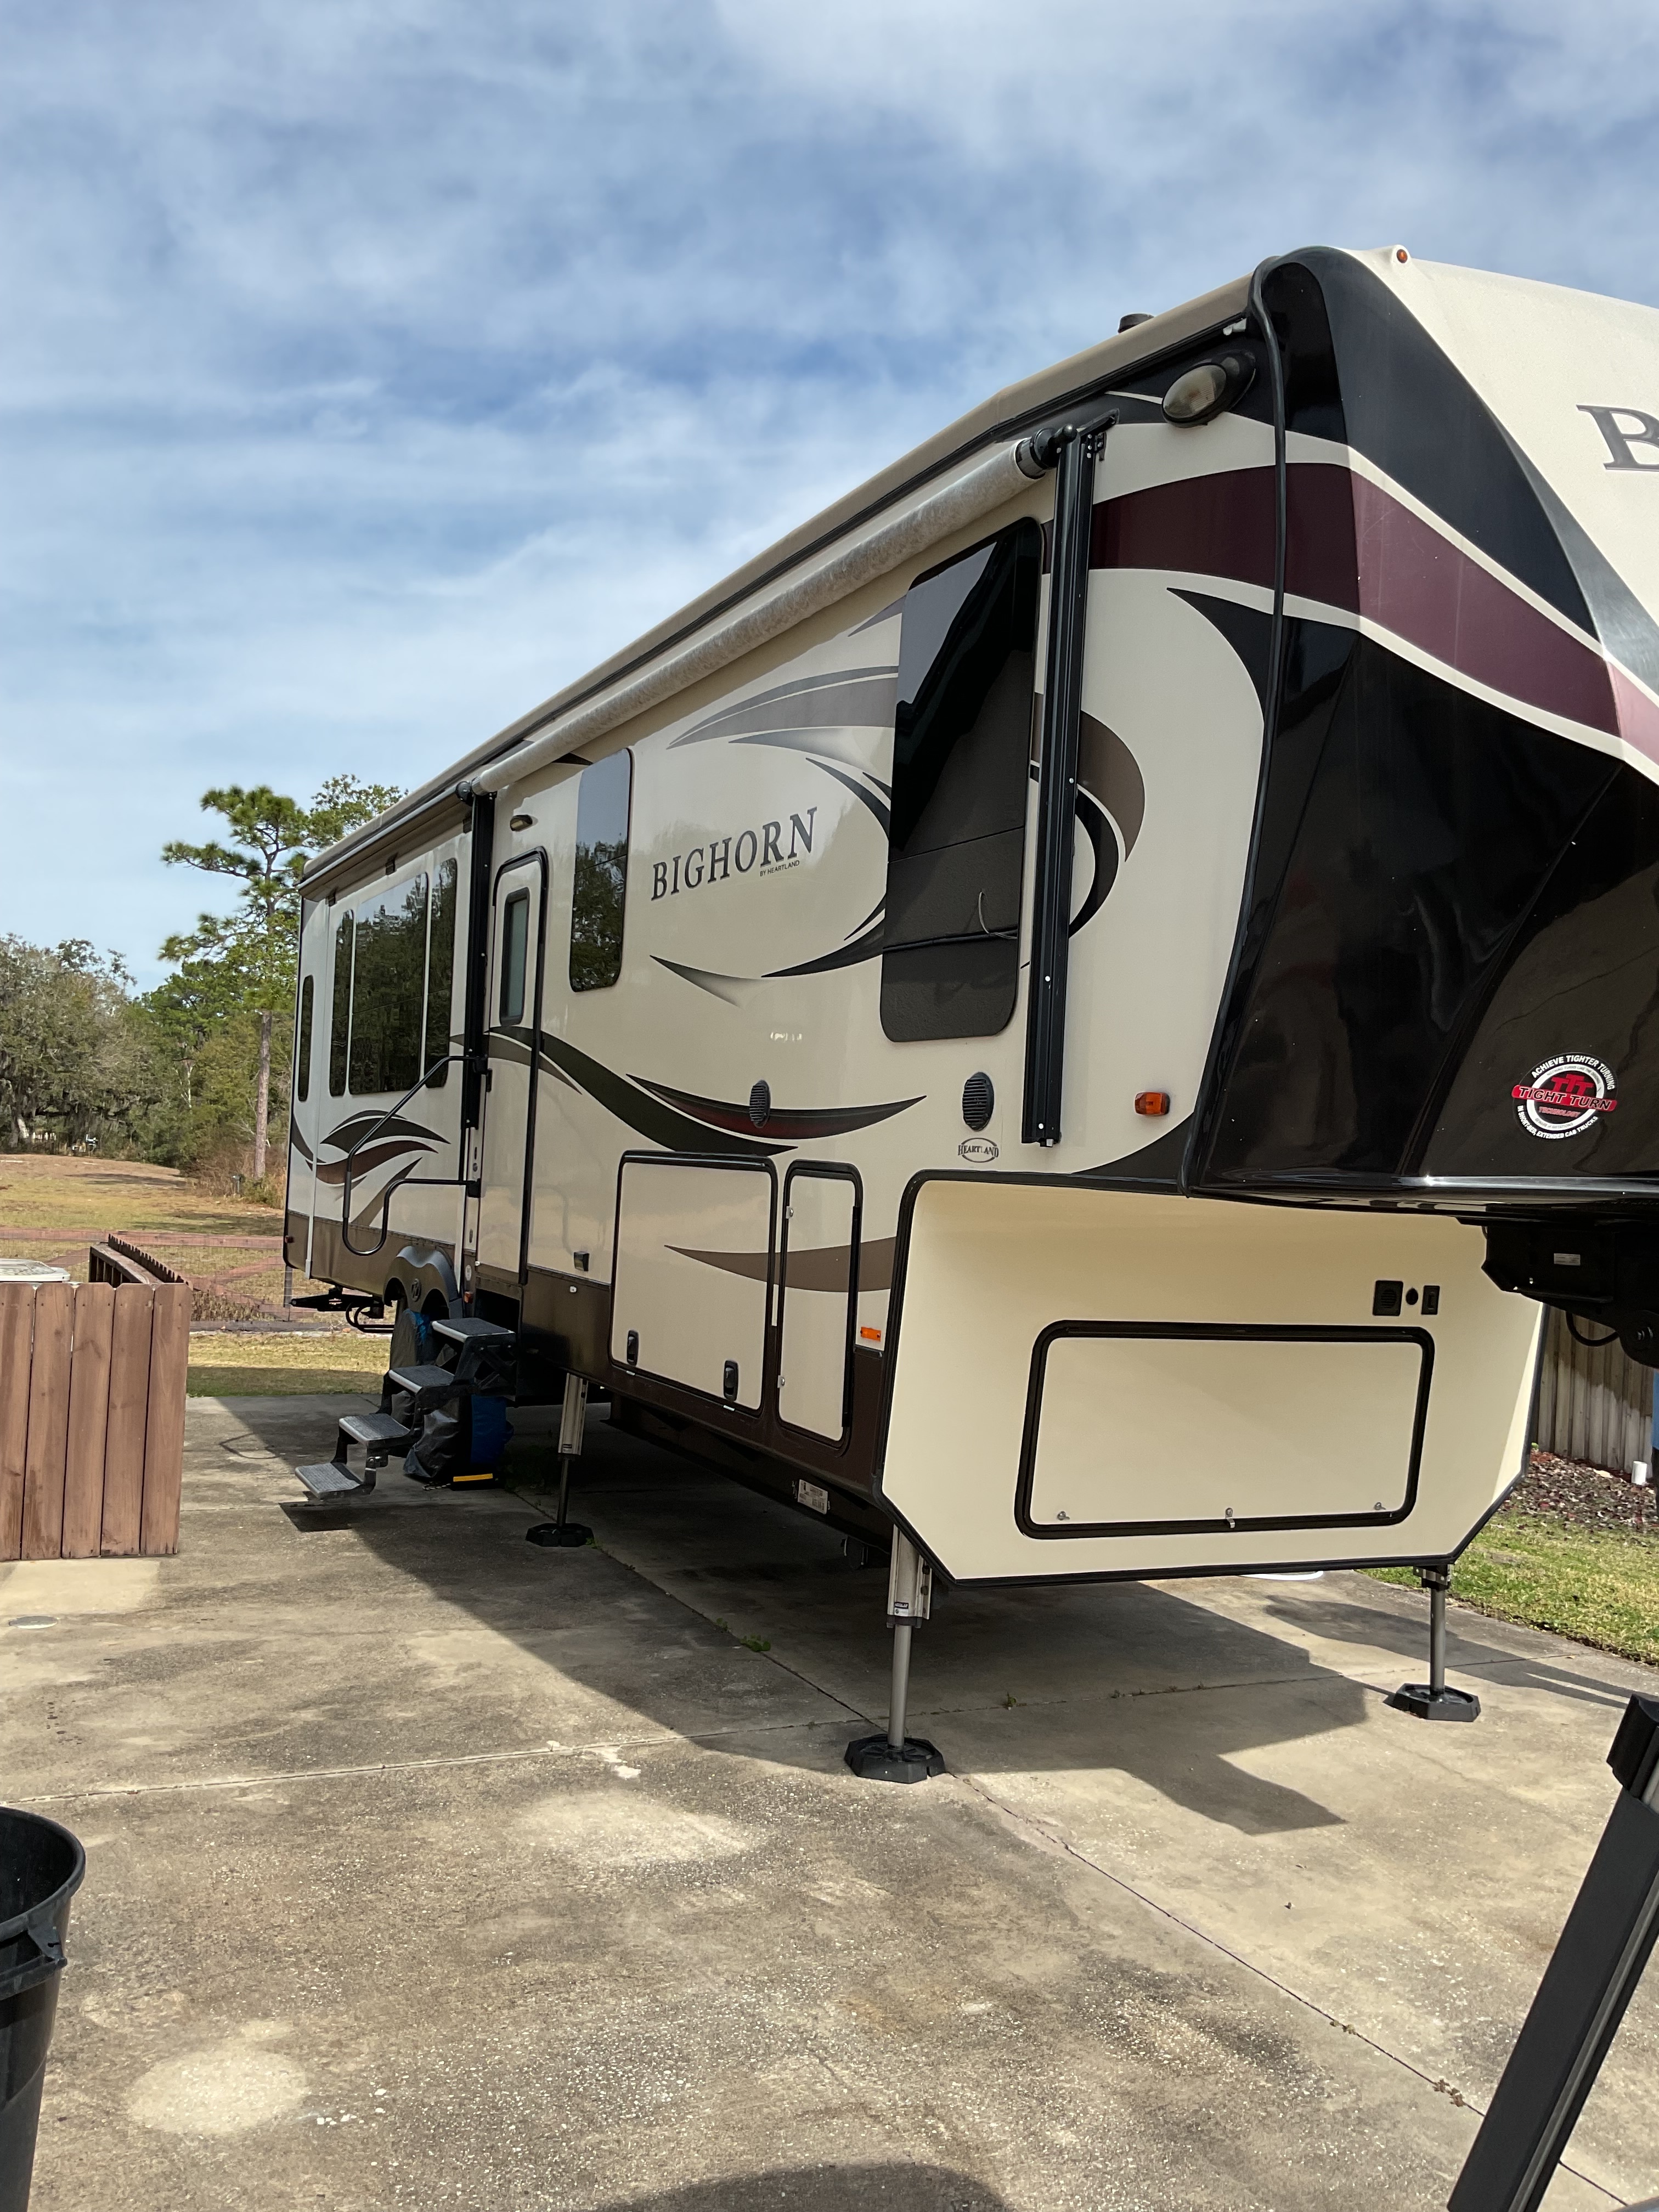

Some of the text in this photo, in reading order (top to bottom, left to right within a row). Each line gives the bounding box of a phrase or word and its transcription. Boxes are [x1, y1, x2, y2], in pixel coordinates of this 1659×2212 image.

[651, 806, 817, 901] BIGHORN
[759, 860, 800, 877] BY HEARTLAND
[1531, 1054, 1616, 1091] ACHIEVE TIGHTER TURNING
[1519, 1086, 1612, 1110] TIGHT TURN
[1536, 1130, 1565, 1139] EXTENDED
[1565, 1129, 1577, 1137] CAB
[1576, 1115, 1598, 1132] TRUCKS
[957, 1144, 999, 1158] HEARTLAND
